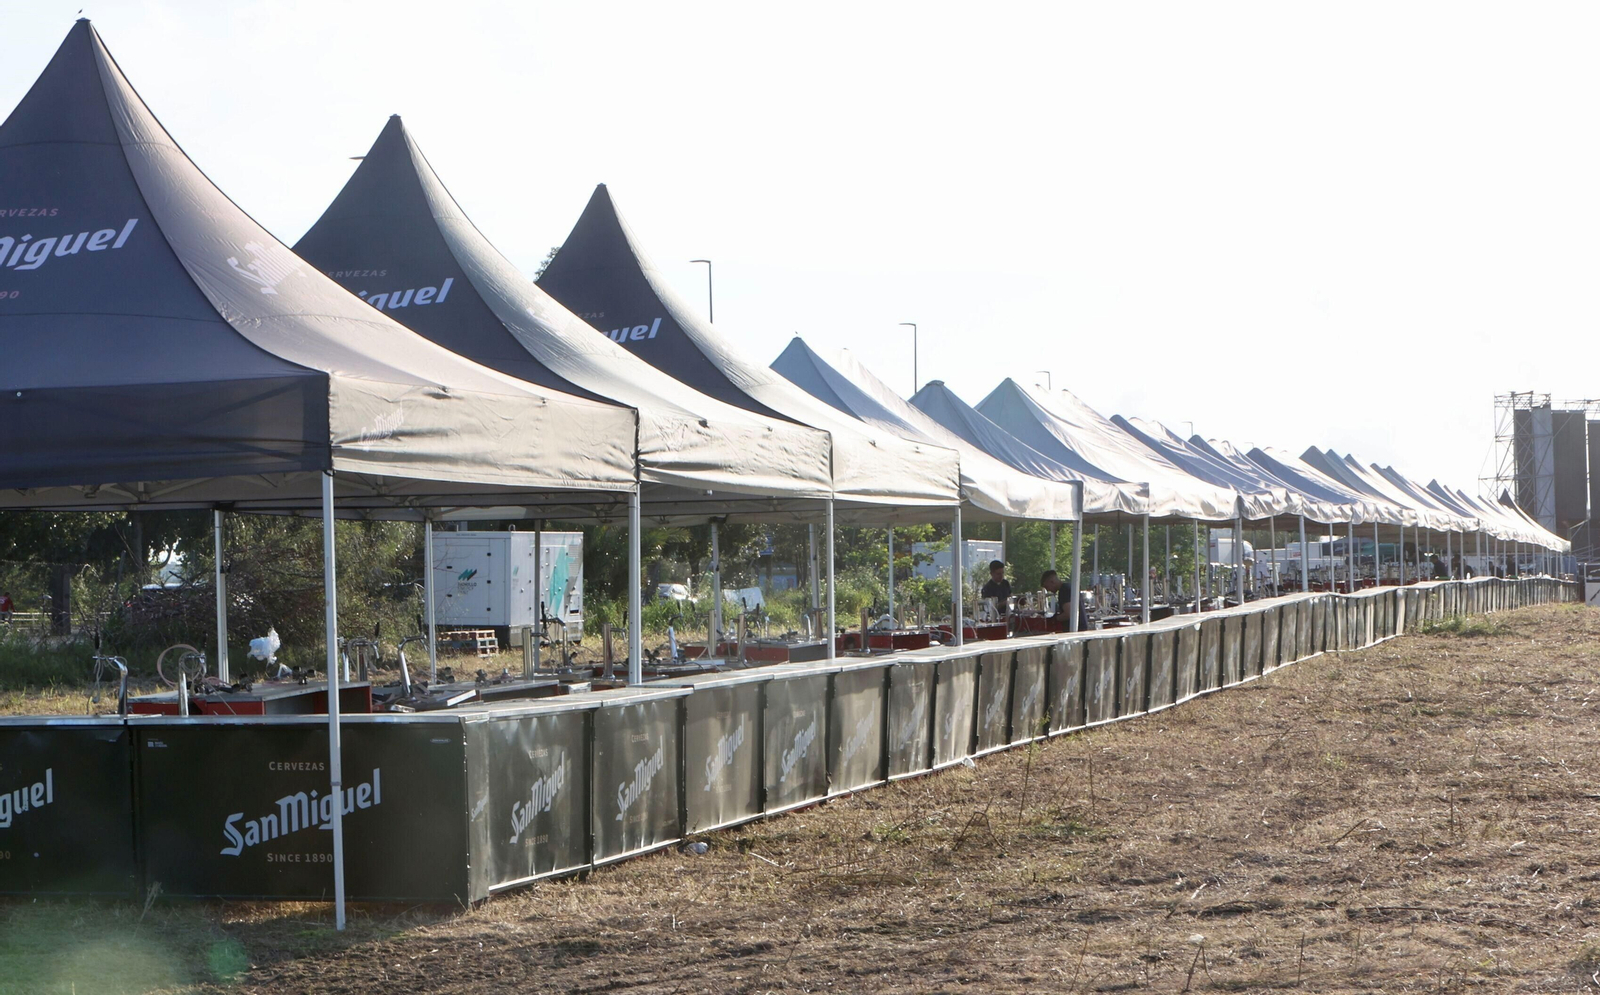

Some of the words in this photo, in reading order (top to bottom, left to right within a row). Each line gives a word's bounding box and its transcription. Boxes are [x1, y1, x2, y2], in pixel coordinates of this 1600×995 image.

[268, 761, 325, 771] CERVEZAS
[219, 767, 381, 857] SanMiguel
[266, 853, 301, 862] SINCE
[304, 853, 334, 863] 1890
